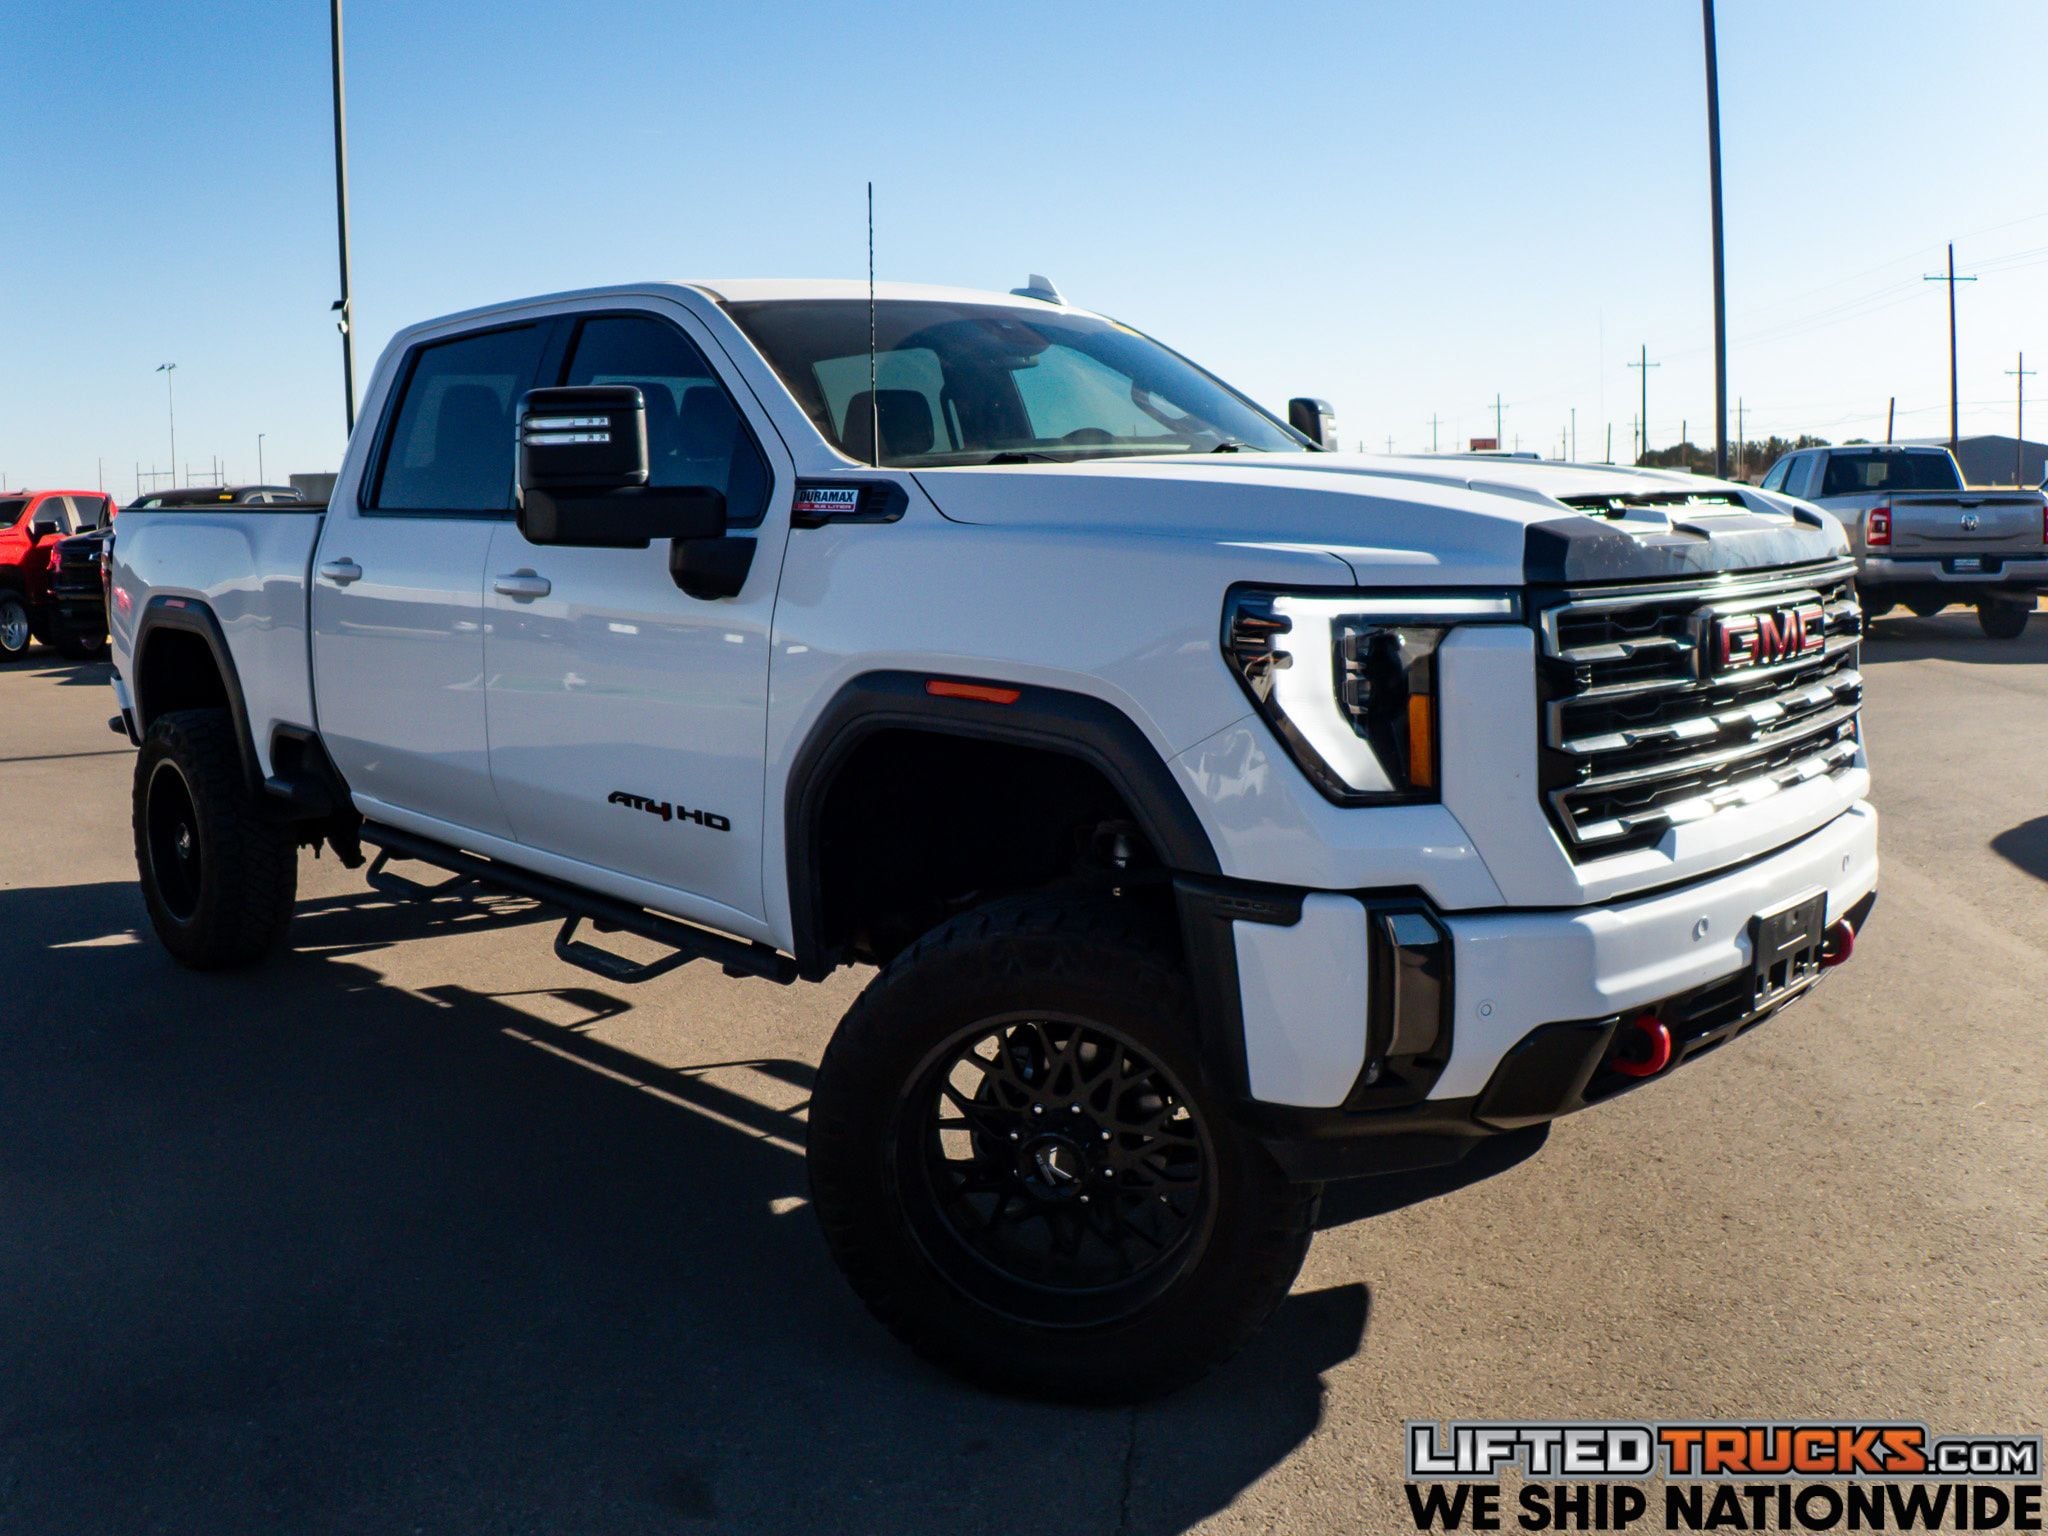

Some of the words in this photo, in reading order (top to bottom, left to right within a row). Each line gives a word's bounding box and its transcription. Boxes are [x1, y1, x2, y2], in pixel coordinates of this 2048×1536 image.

[800, 491, 854, 502] DURAMAX
[1718, 603, 1824, 667] GMC
[608, 791, 672, 822] AT4
[677, 805, 731, 832] HD
